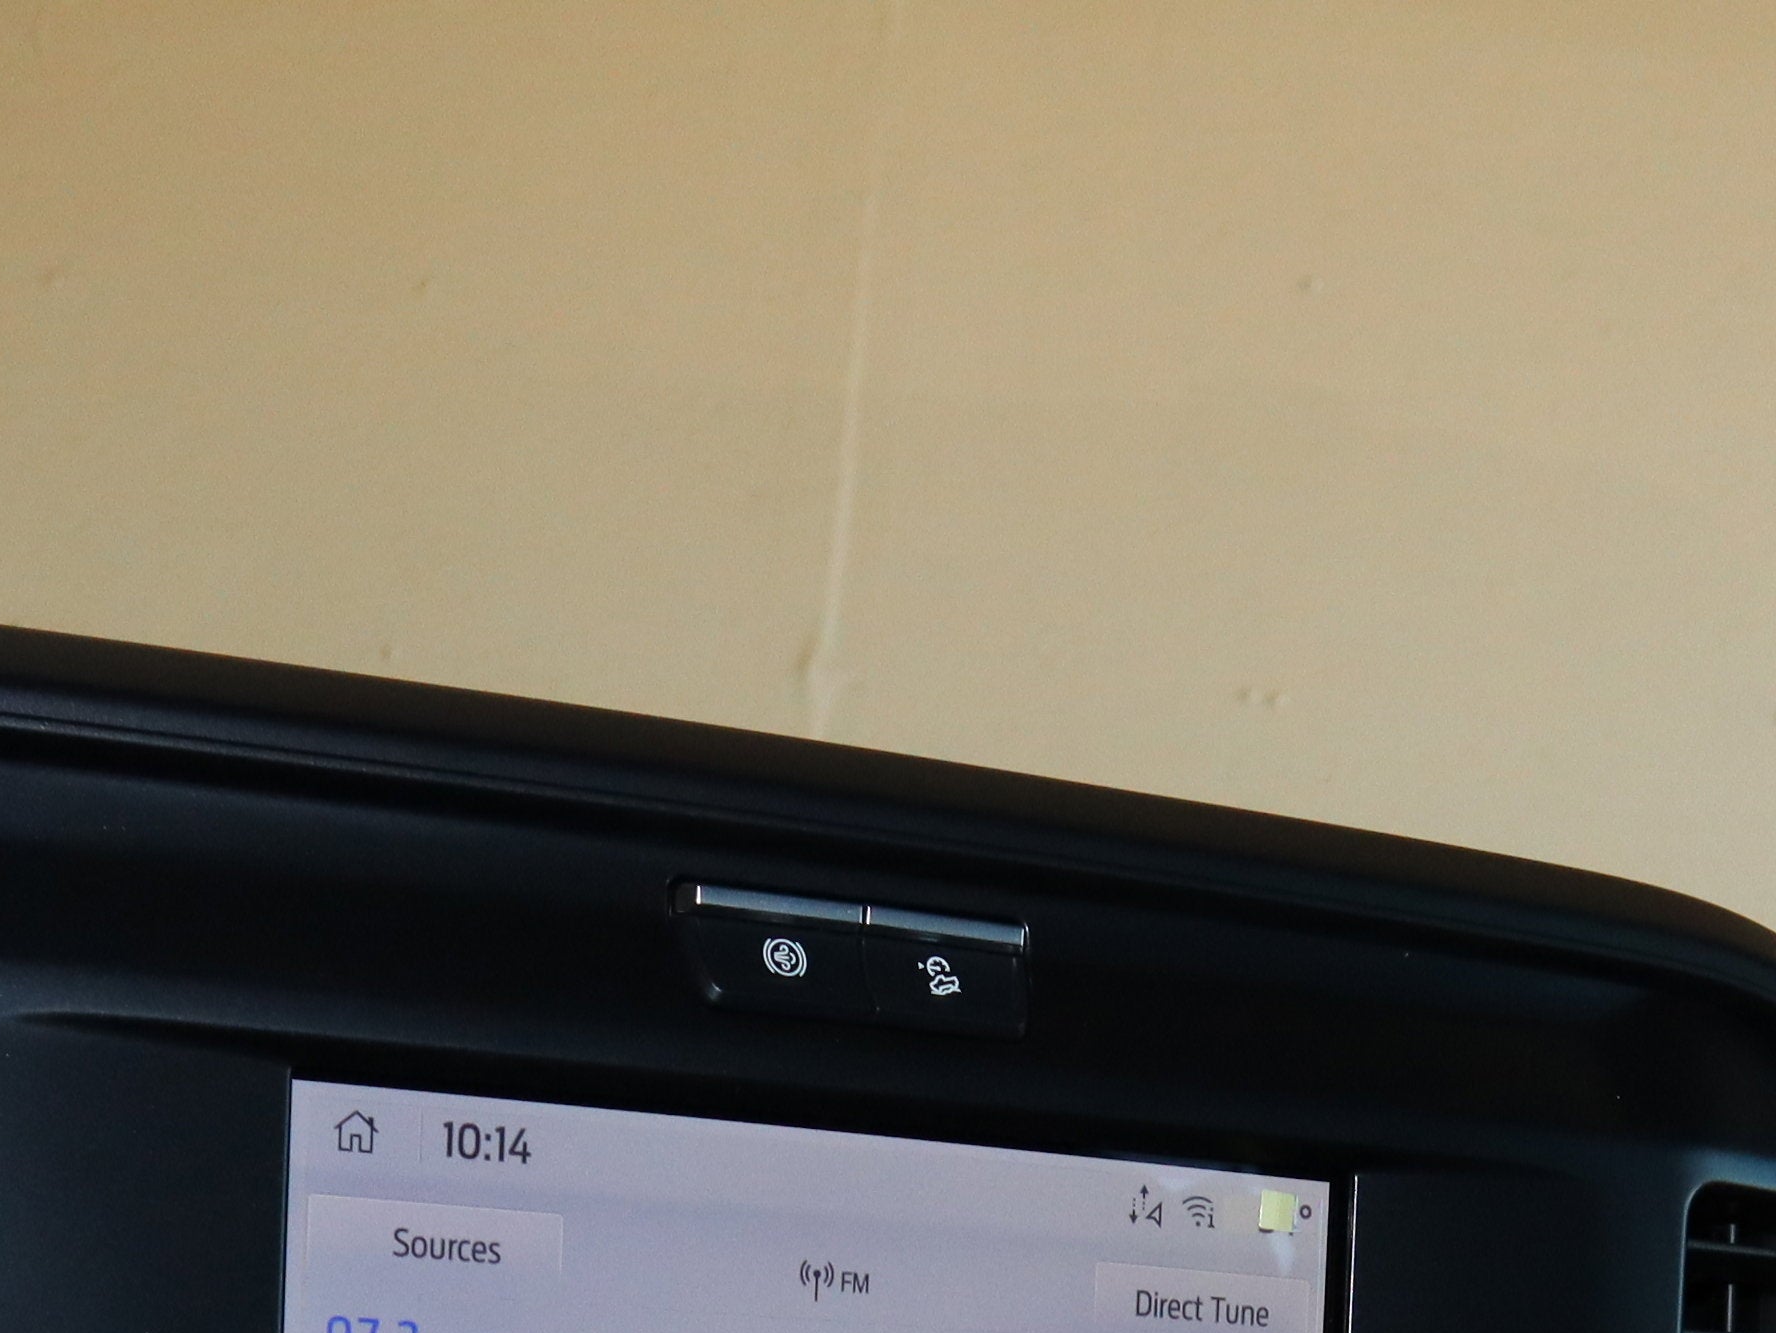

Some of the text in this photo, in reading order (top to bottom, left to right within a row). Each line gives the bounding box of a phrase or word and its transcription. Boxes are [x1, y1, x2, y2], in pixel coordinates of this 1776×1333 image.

[443, 1120, 531, 1164] 10:14
[392, 1228, 501, 1264] Sources
[840, 1272, 869, 1294] FM
[1135, 1290, 1269, 1327] Direct Tune
